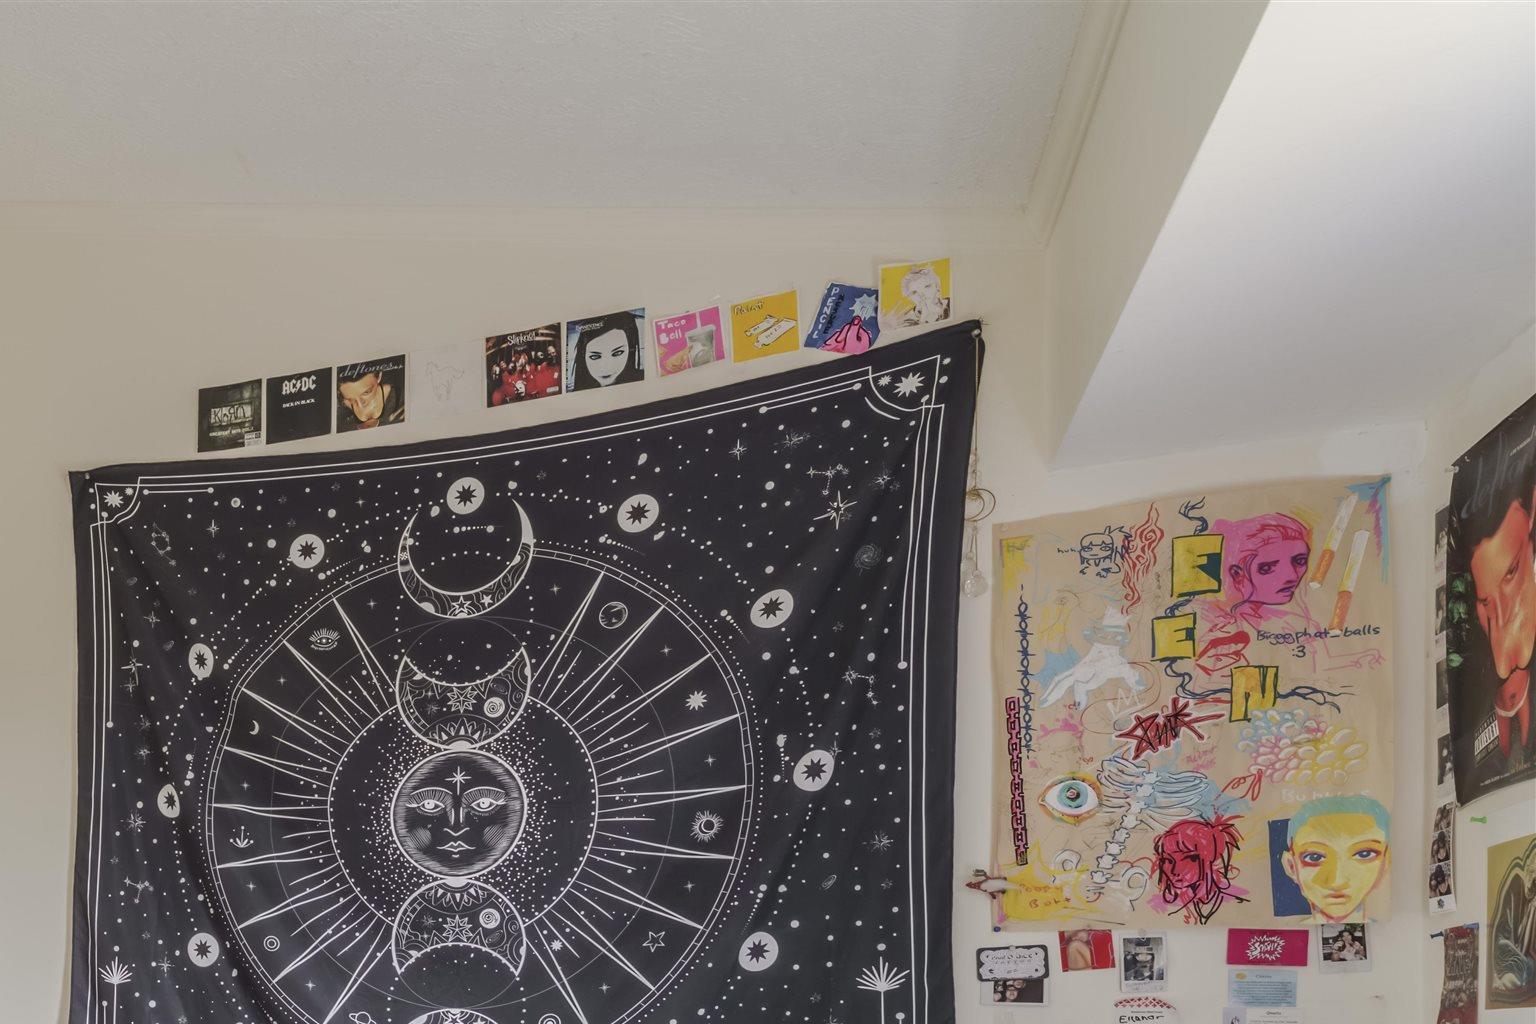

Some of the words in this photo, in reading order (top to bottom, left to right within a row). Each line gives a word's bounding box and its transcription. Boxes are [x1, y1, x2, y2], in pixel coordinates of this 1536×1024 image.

[811, 286, 840, 339] PENCIL
[657, 319, 686, 330] Taco
[659, 329, 682, 344] Bell
[282, 375, 317, 395] AC/DC
